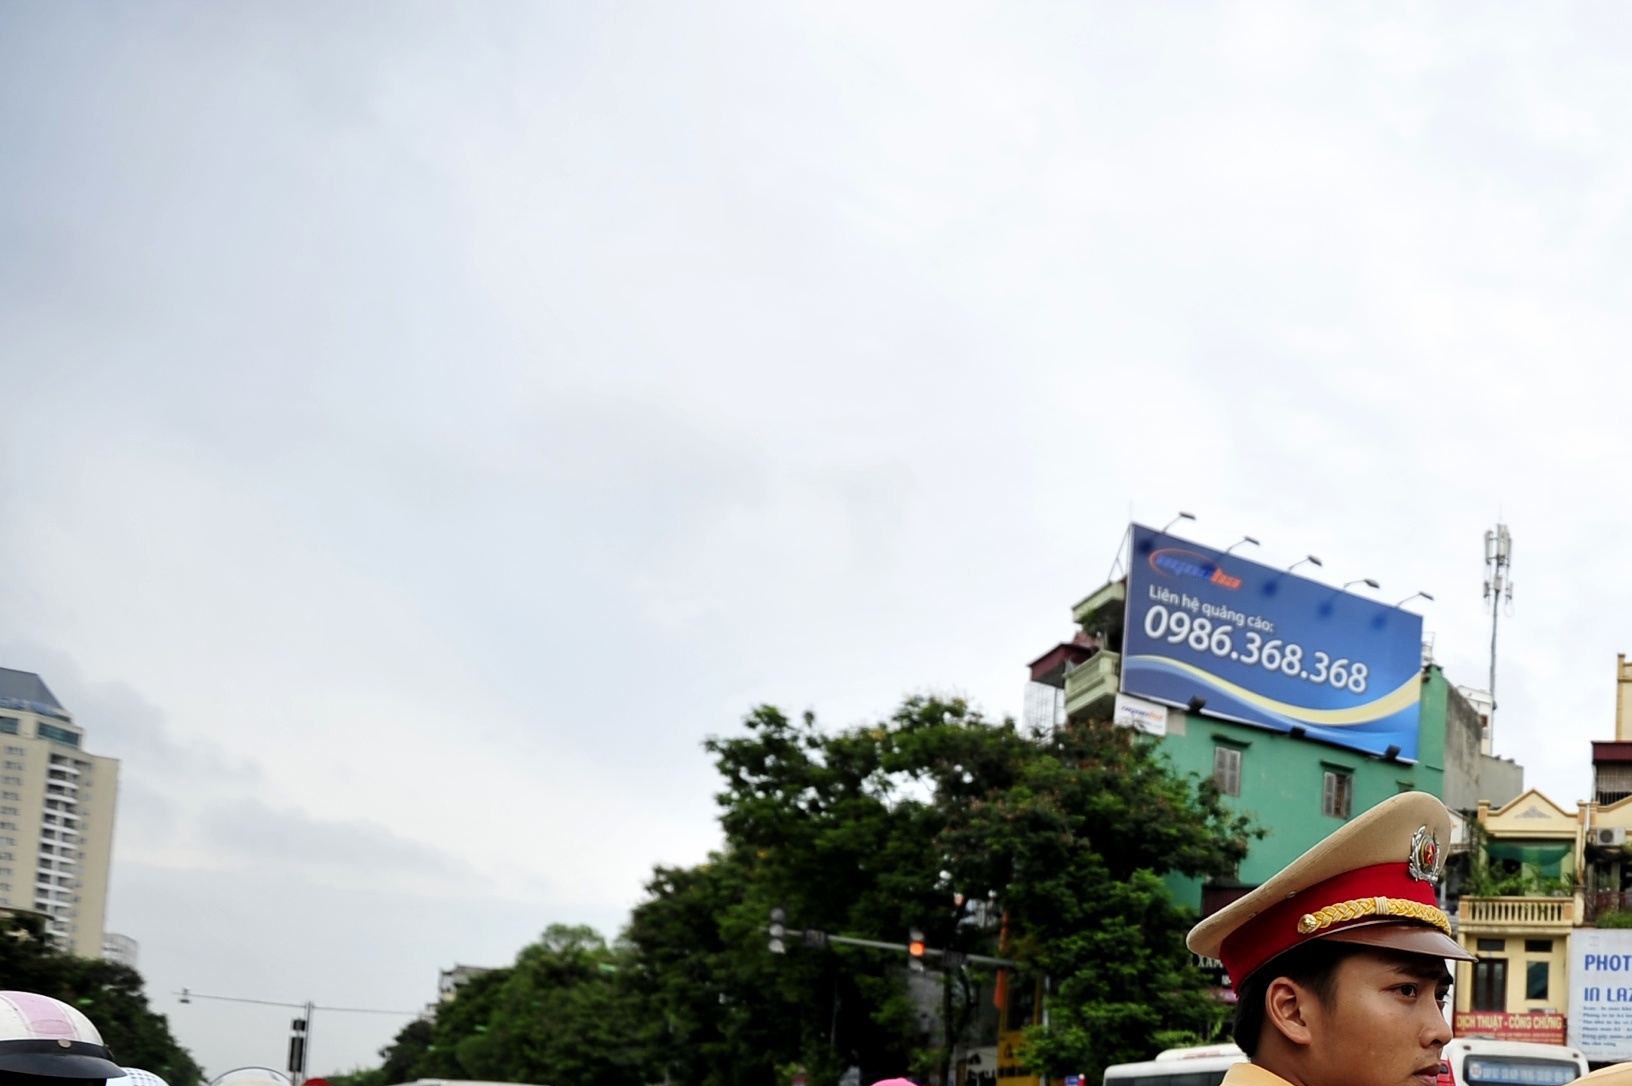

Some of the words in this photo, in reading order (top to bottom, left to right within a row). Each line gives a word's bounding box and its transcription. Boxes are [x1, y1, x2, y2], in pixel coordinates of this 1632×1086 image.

[1149, 584, 1179, 606] Liên
[1181, 592, 1200, 613] hệ
[1202, 601, 1244, 627] quảng
[1247, 614, 1274, 632] cáo:
[1144, 604, 1370, 695] 0986.368.368
